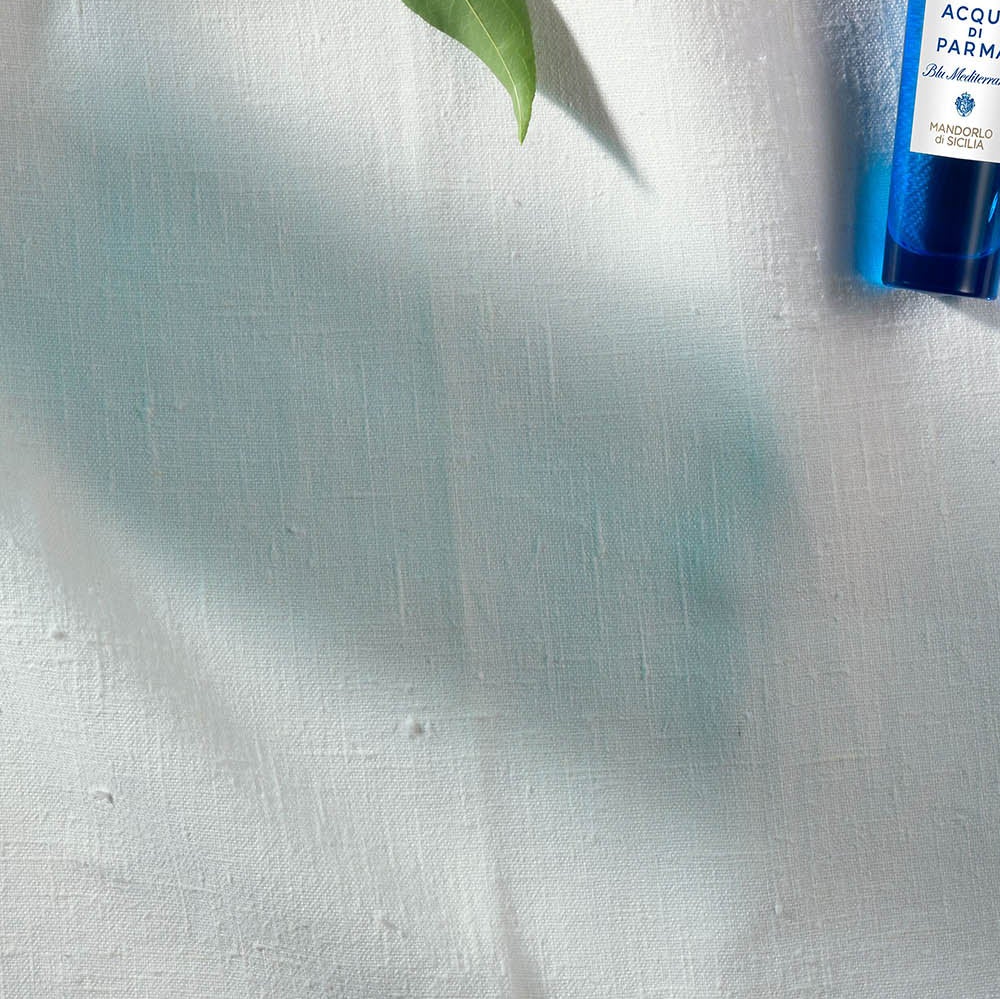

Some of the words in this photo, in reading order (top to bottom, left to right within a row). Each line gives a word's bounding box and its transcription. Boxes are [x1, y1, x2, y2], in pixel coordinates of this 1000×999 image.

[968, 27, 983, 39] DI
[922, 63, 945, 80] Blu
[929, 121, 994, 139] MANDORLO
[935, 134, 945, 145] di
[946, 135, 985, 150] SICILIA
